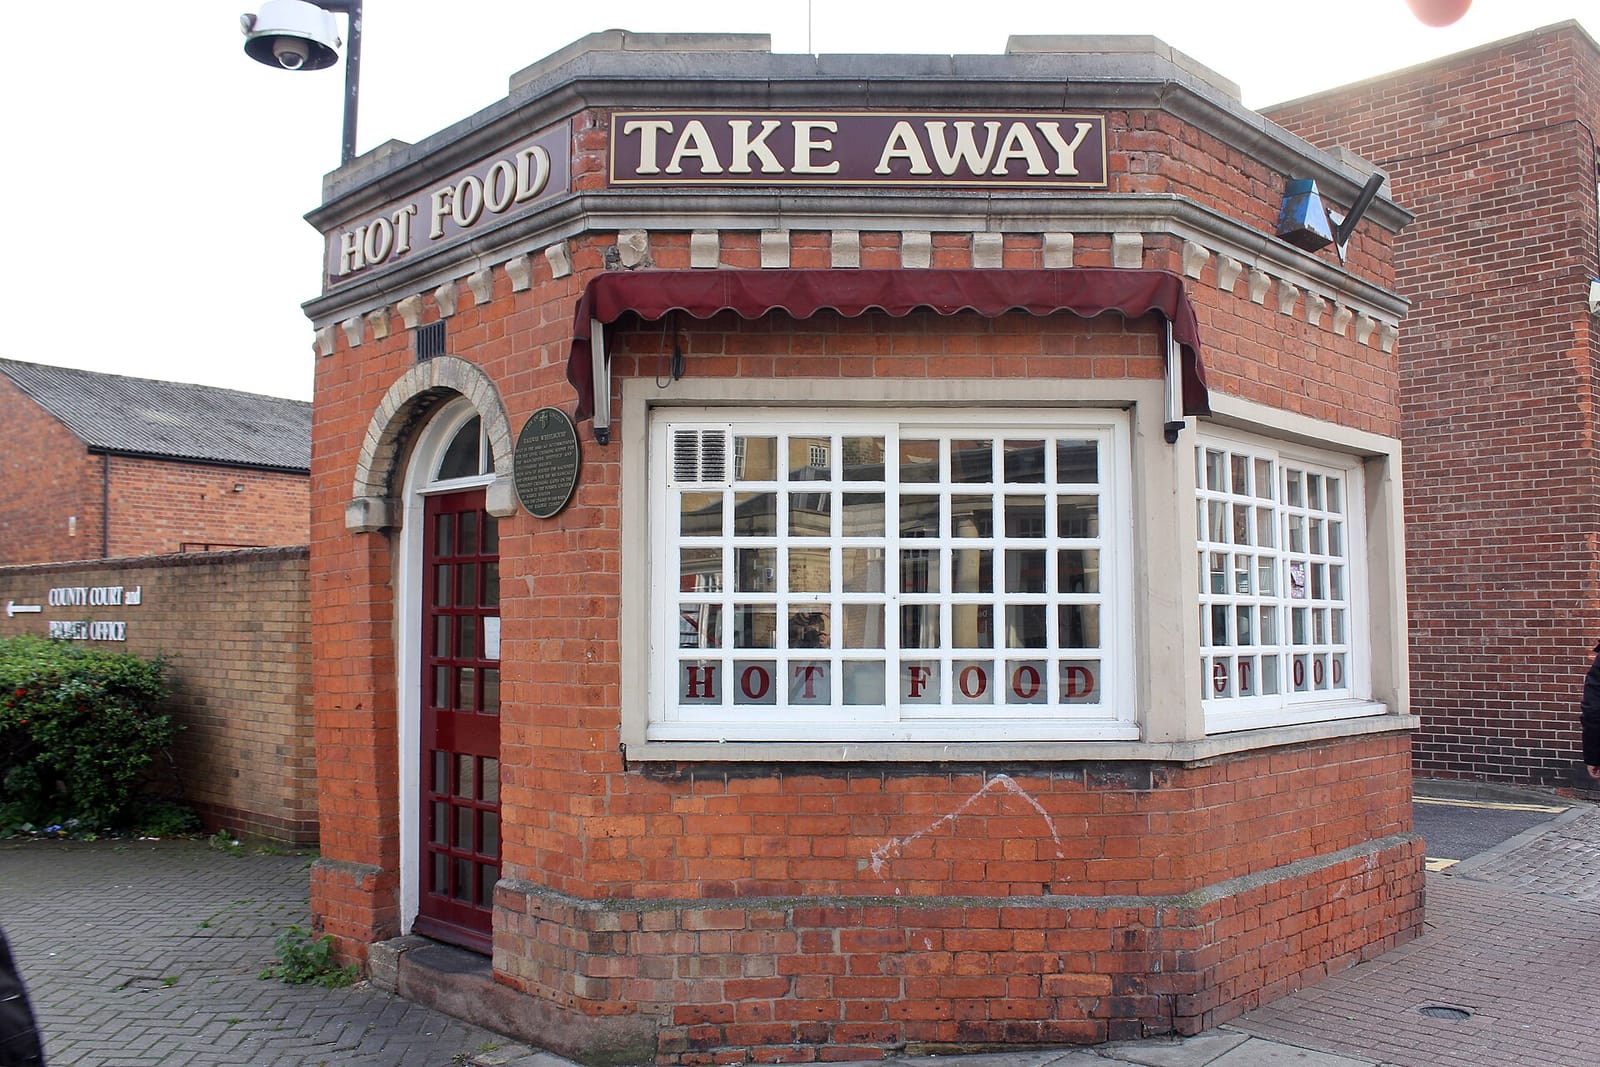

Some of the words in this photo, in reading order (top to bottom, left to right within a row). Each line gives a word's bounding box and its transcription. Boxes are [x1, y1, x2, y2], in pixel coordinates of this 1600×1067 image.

[623, 120, 841, 174] TAKE
[874, 121, 1093, 176] AWAY
[338, 203, 418, 277] HOT
[429, 144, 551, 240] FOOD
[48, 587, 89, 606] COUNTY
[90, 586, 124, 606] COURT
[90, 621, 126, 641] OFFICE
[686, 666, 824, 699] HOT
[908, 666, 1094, 699] FOOD
[1213, 661, 1251, 693] OT
